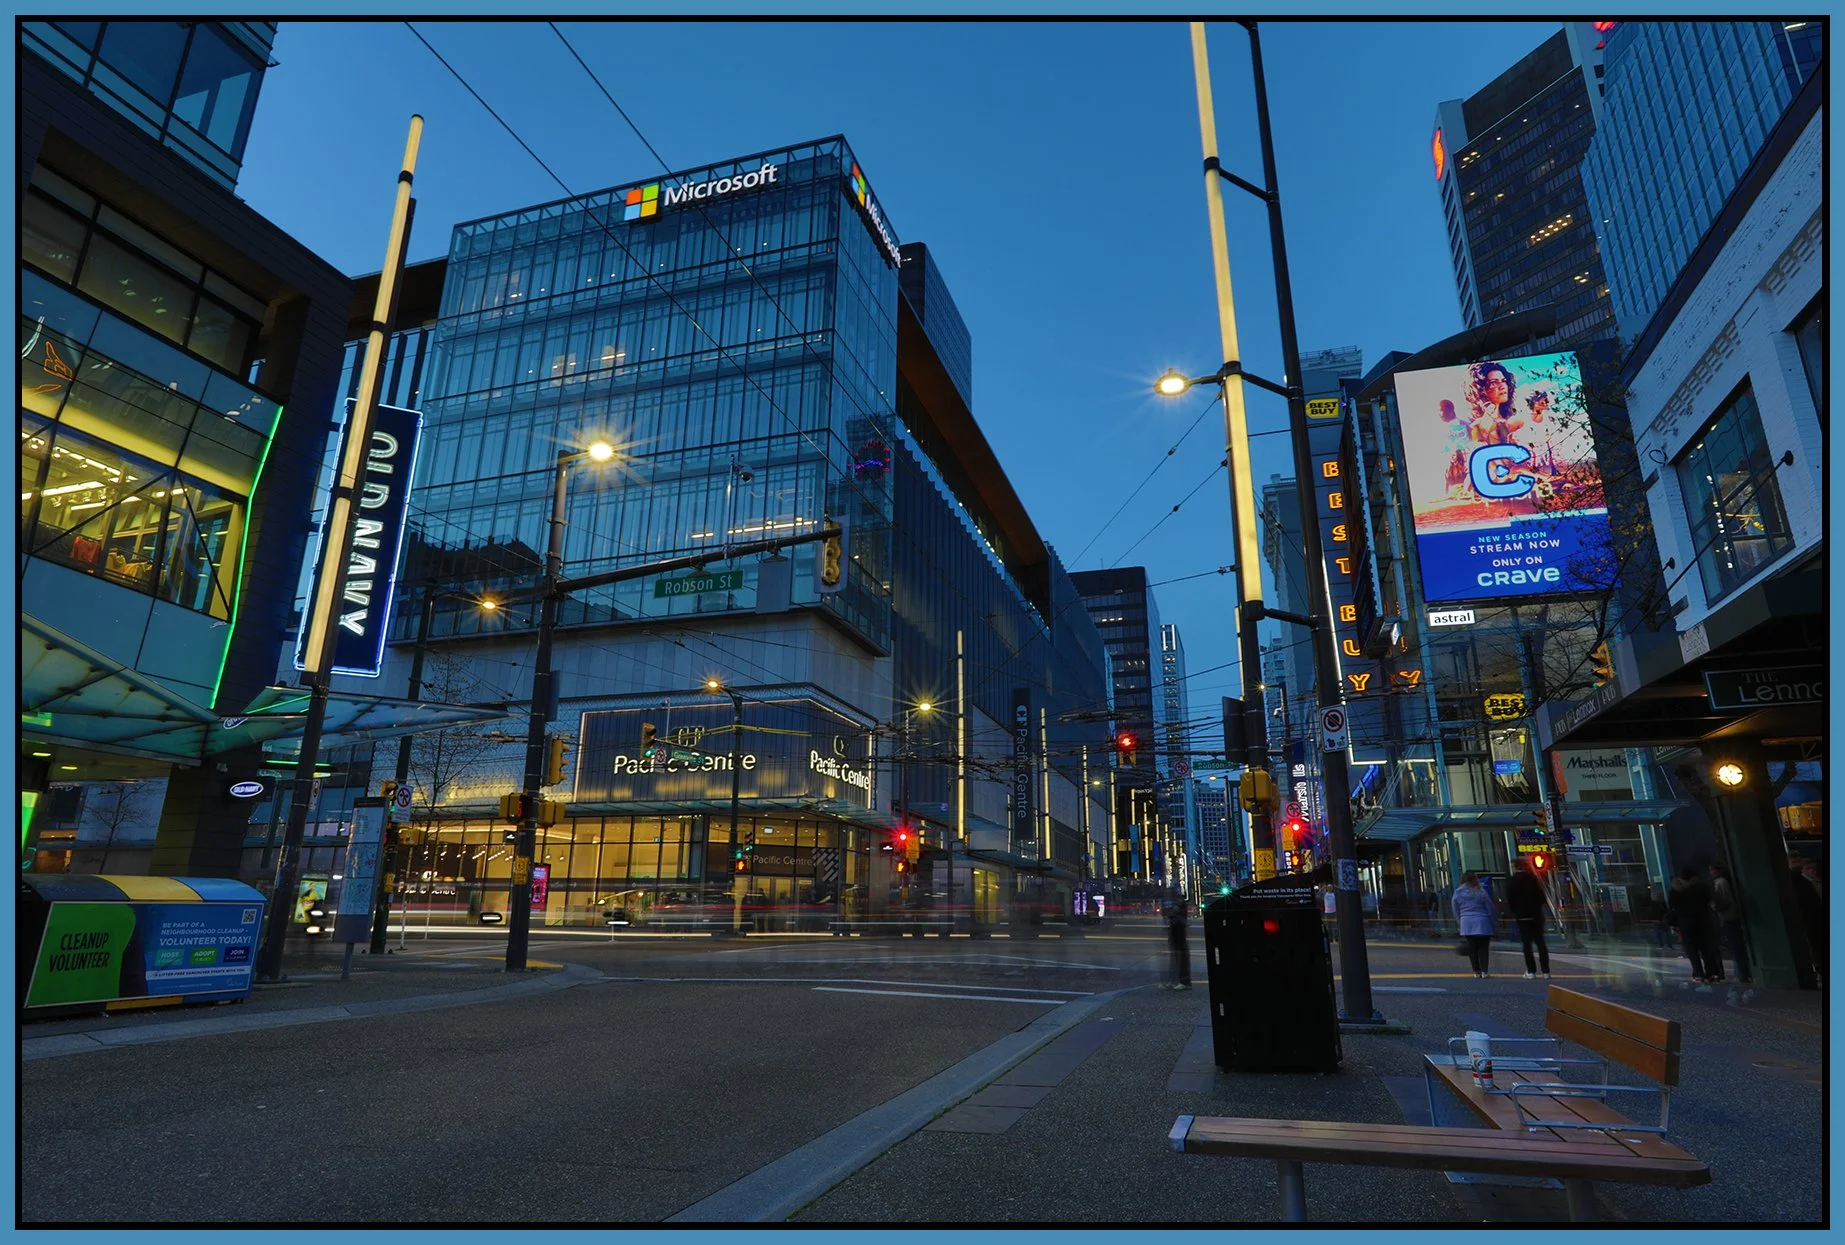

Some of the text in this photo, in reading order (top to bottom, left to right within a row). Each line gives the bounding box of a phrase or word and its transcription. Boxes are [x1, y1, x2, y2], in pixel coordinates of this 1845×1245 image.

[664, 163, 778, 206] Microsoft
[865, 193, 901, 268] Microsoft
[1322, 460, 1351, 575] BEST
[1505, 531, 1547, 541] SEASON
[1470, 539, 1560, 554] STREAM NOW
[1492, 556, 1543, 567] ONLY ON
[338, 517, 384, 637] NAVY
[664, 575, 732, 595] Robson St
[1434, 612, 1471, 624] astral
[1741, 671, 1778, 684] THE
[810, 749, 869, 790] Pacific Centre
[1566, 754, 1628, 769] Marshalls
[1017, 773, 1029, 818] Centre
[1518, 844, 1548, 852] BEST
[753, 855, 813, 866] Pacific Centre
[60, 930, 109, 950] CLEANUP
[160, 936, 252, 946] VOLUNTEER TODAY!
[49, 951, 110, 973] VOLUNTEER
